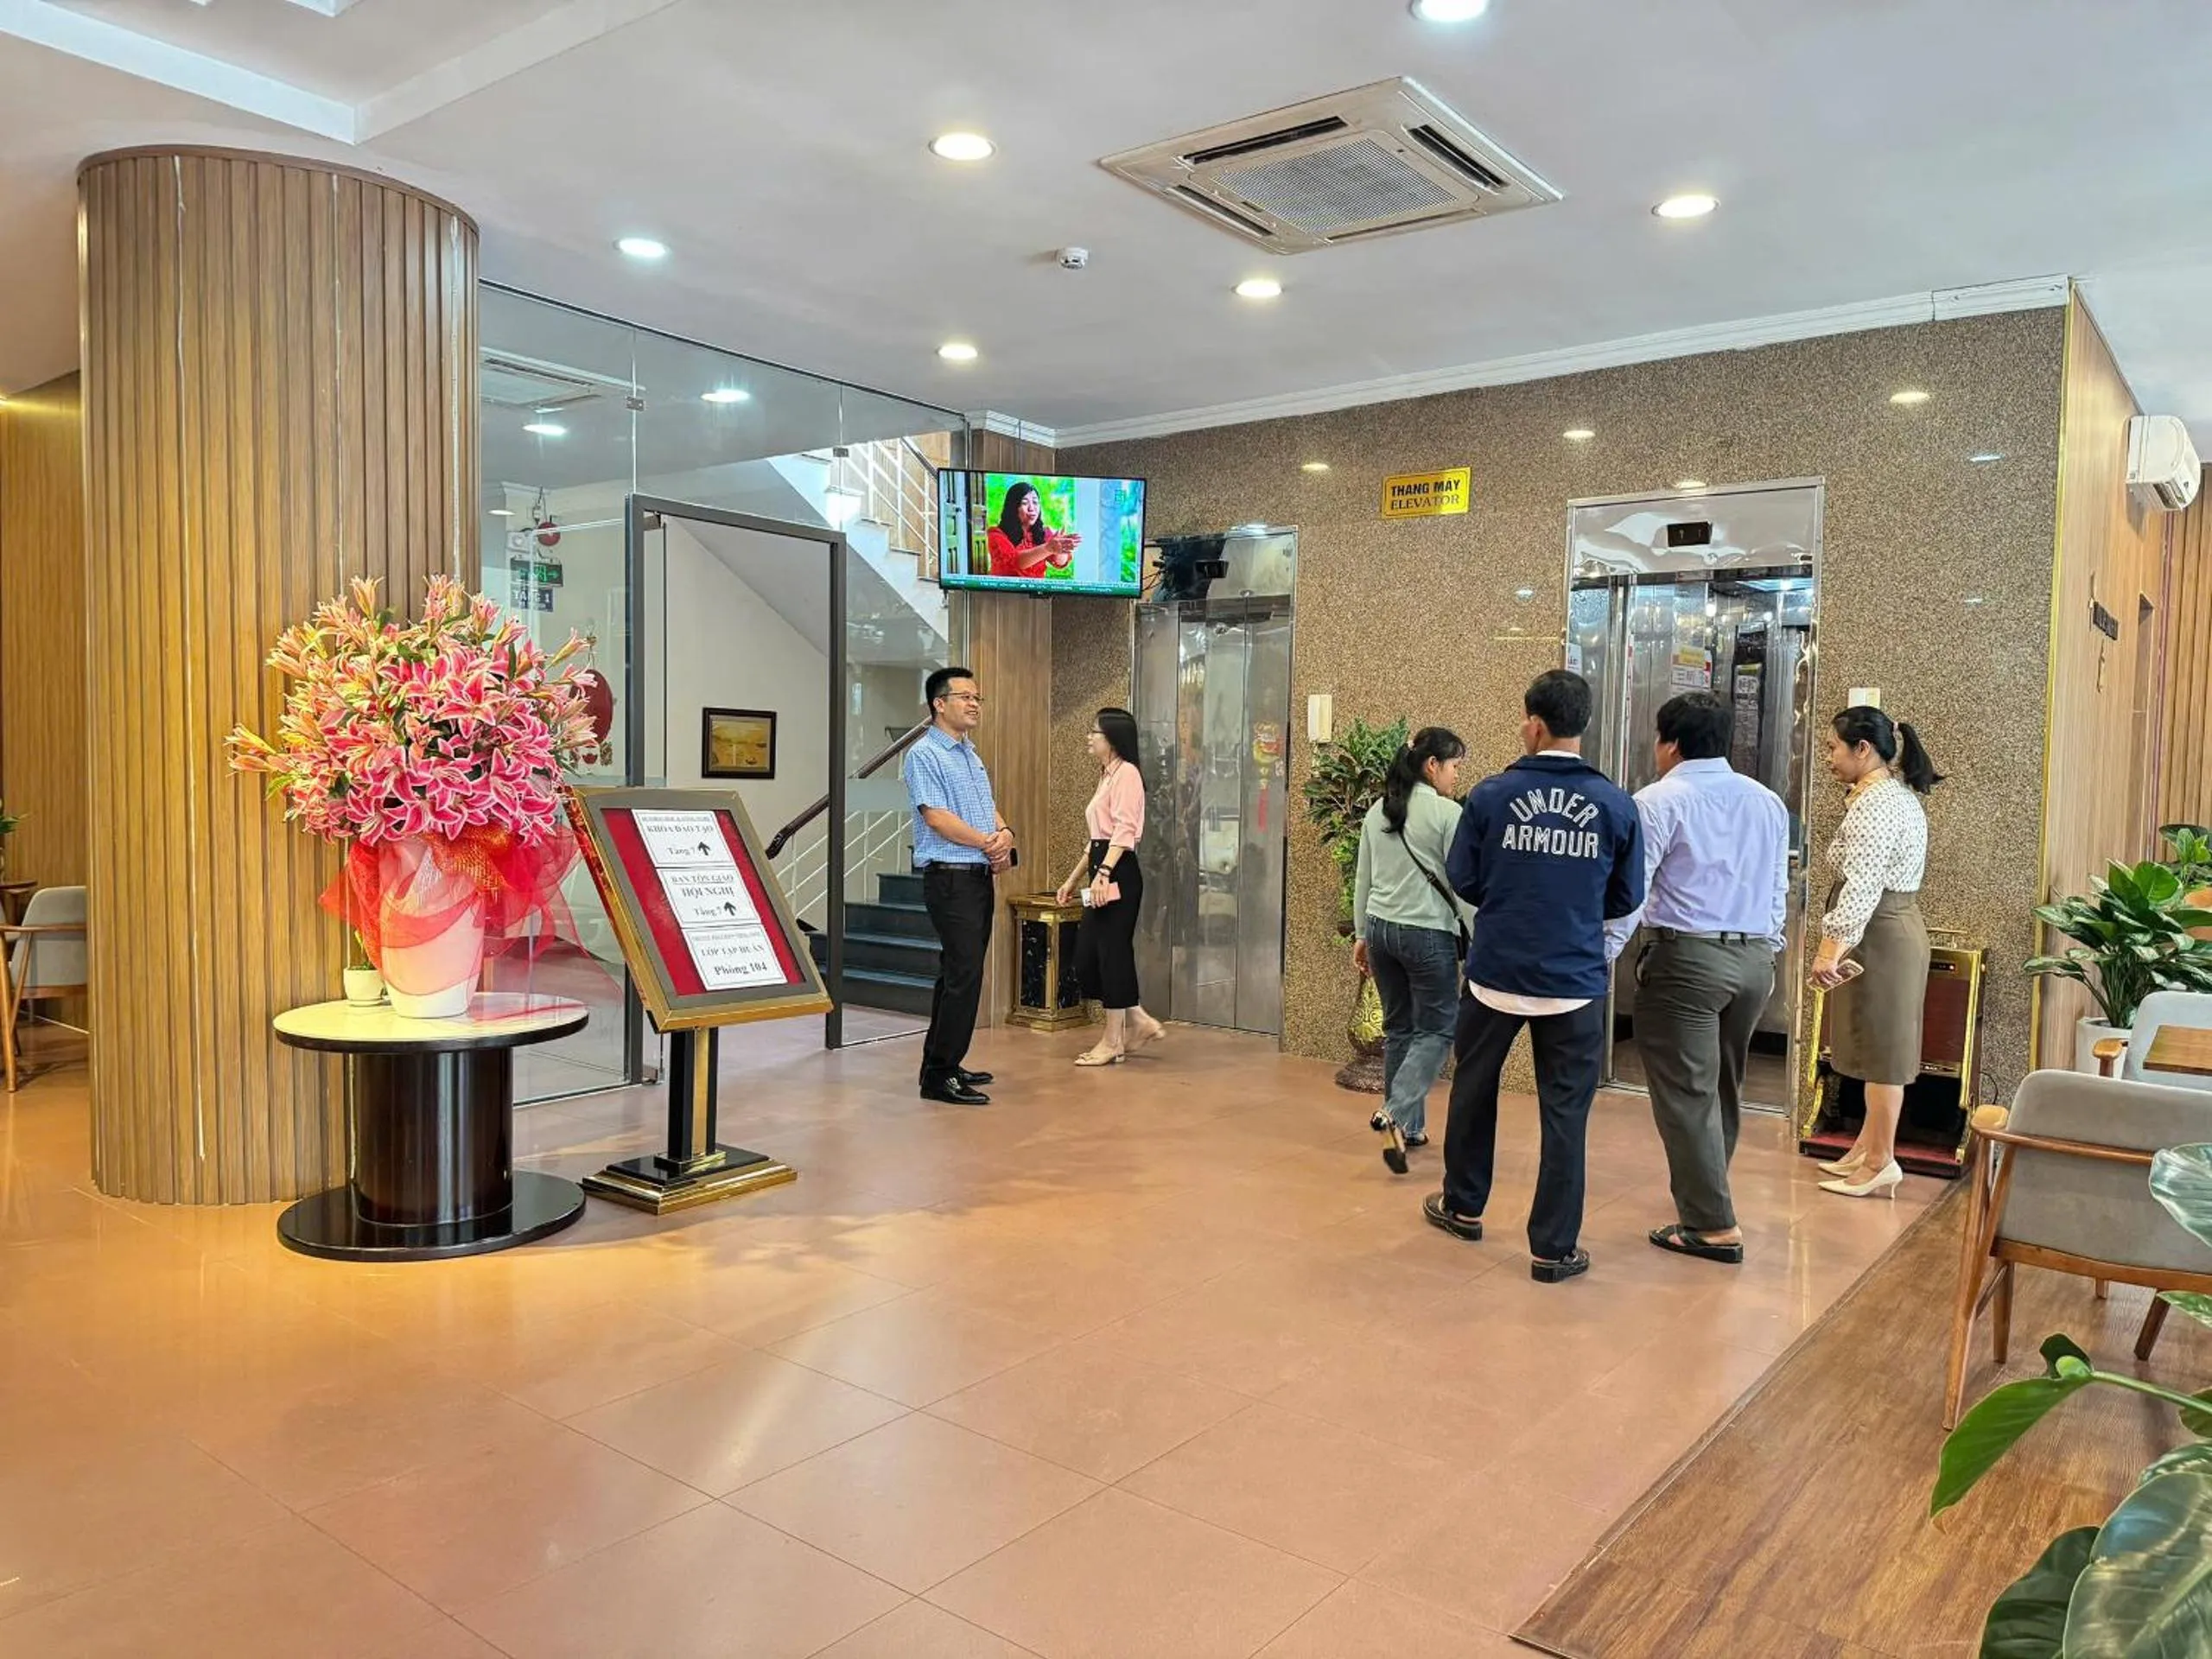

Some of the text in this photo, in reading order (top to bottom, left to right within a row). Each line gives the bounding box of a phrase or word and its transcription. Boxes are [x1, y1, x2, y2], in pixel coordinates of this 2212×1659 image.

[1391, 477, 1460, 497] THANG MÁY
[1390, 493, 1459, 510] ELEVATOR
[1510, 787, 1599, 829] UNDER
[1502, 823, 1599, 859] ARMOUR
[750, 961, 767, 972] 104
